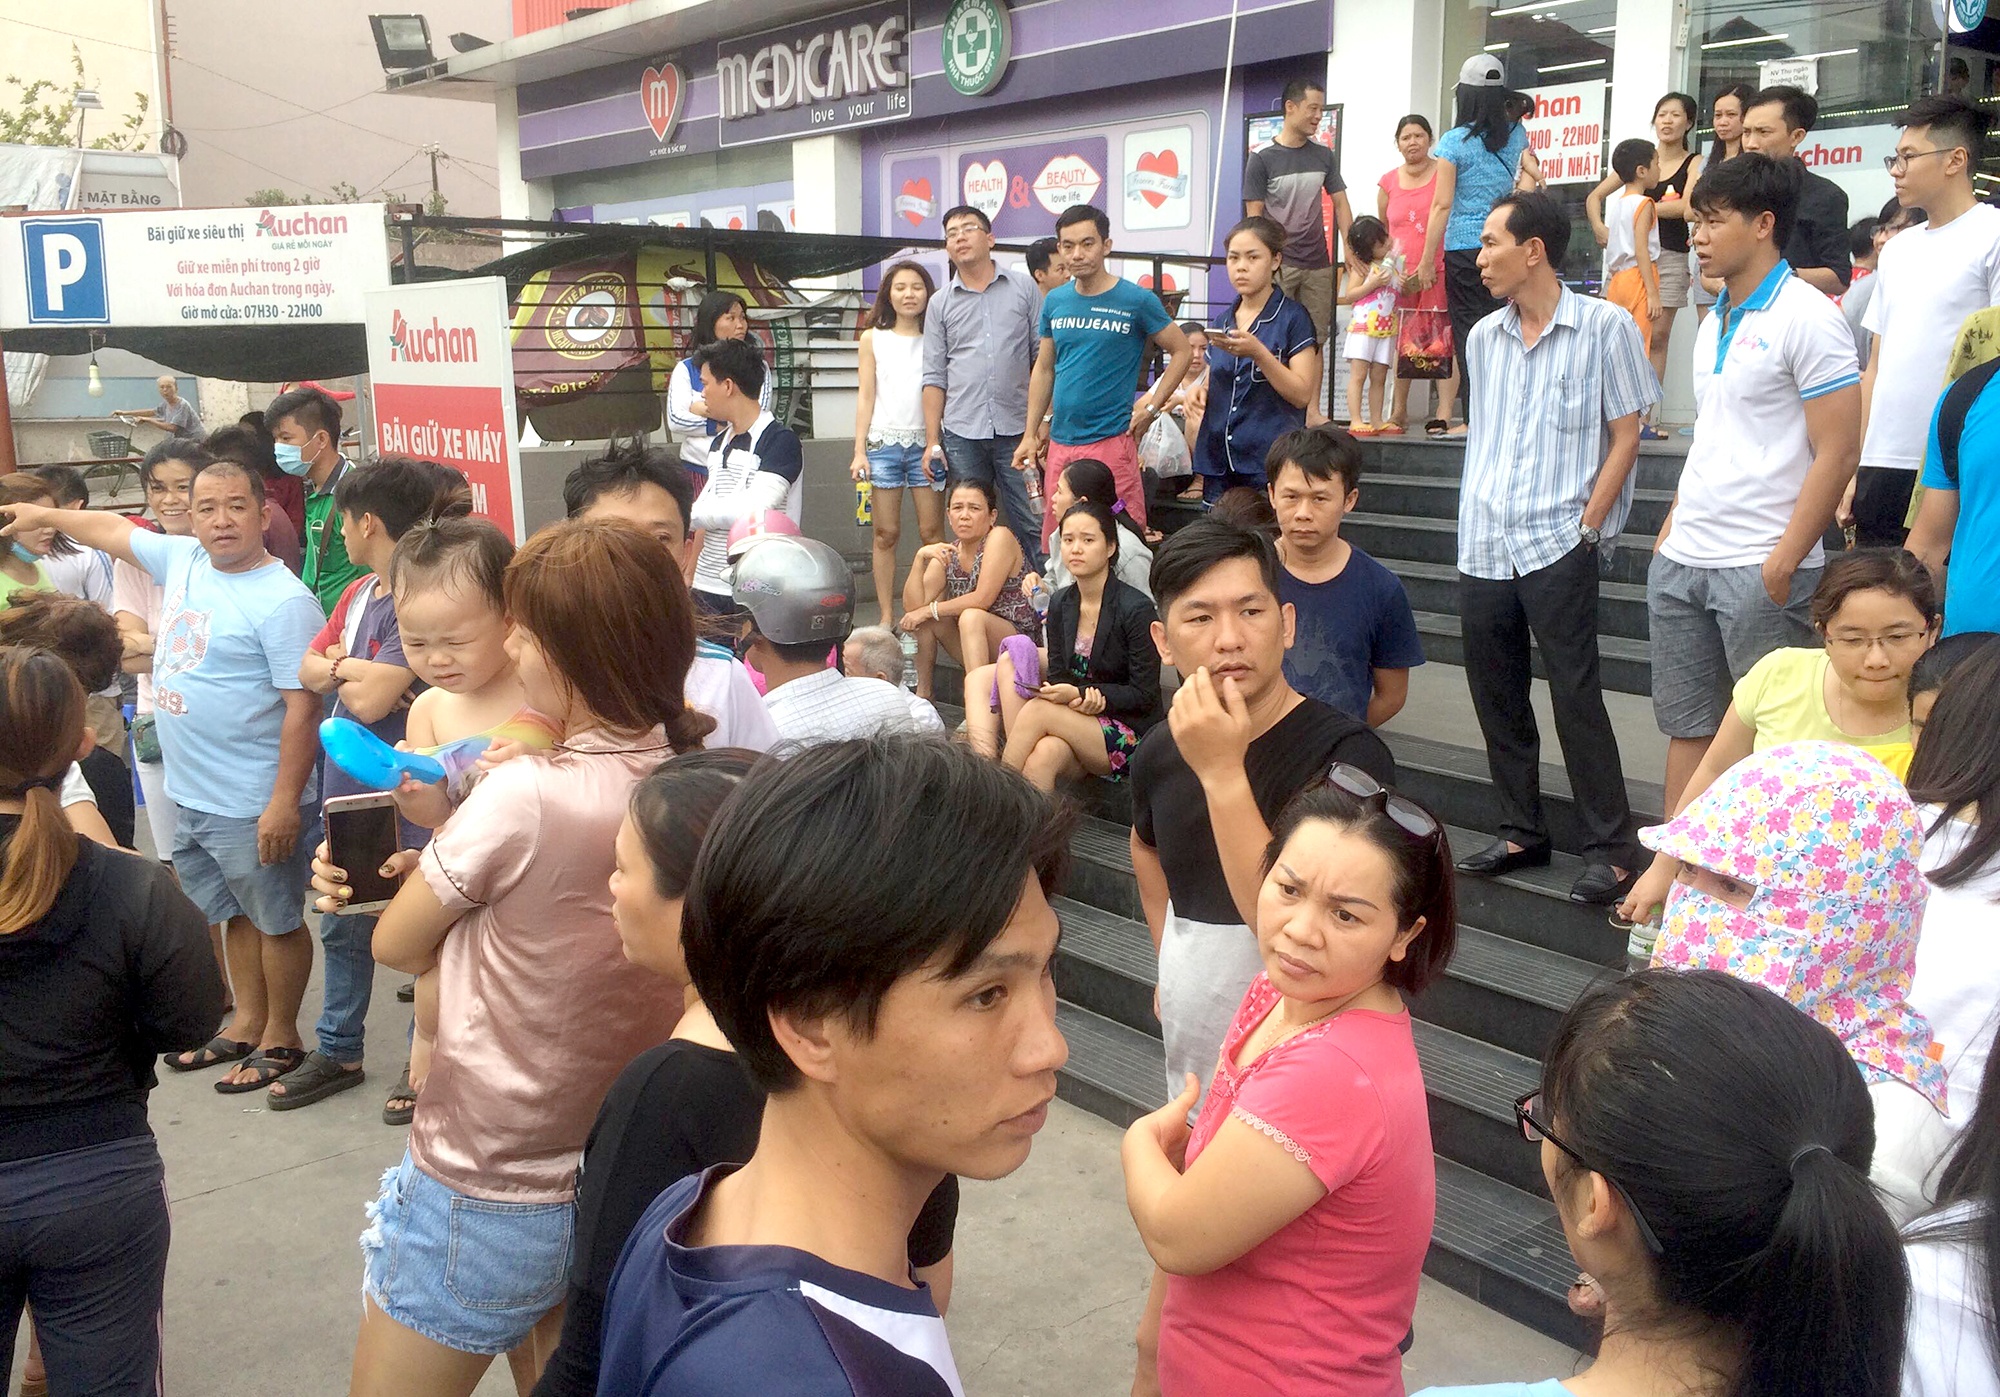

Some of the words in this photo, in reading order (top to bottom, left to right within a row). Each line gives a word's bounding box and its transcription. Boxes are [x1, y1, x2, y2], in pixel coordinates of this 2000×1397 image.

[947, 0, 997, 40] PHARMACY
[984, 51, 995, 74] GPP
[811, 108, 835, 124] love
[848, 102, 875, 120] your
[887, 94, 906, 111] life
[1562, 123, 1600, 147] 22H00
[1541, 152, 1564, 180] CHỦ
[1567, 151, 1600, 180] NHẬT
[968, 178, 1003, 193] HEALTH
[1009, 175, 1031, 209] &
[1046, 169, 1087, 185] BEAUTY
[1051, 193, 1067, 203] love
[1068, 191, 1081, 202] life
[987, 199, 998, 209] life
[147, 226, 165, 241] Bãi
[167, 225, 186, 245] giữ
[188, 227, 201, 240] xe
[203, 224, 226, 240] siêu
[228, 223, 244, 242] thị
[256, 209, 348, 237] Auchan
[42, 233, 87, 311] P
[177, 260, 195, 274] Giữ
[197, 263, 209, 274] xe
[211, 258, 239, 274] miễn
[241, 258, 259, 276] phí
[260, 259, 292, 276] trong
[293, 258, 300, 272] 2
[303, 256, 321, 275] giờ
[166, 283, 183, 297] Với
[185, 282, 205, 297] hóa
[207, 282, 228, 297] đơn
[230, 281, 269, 296] Auchan
[272, 282, 303, 298] trong
[305, 279, 335, 298] ngày.
[181, 305, 199, 319] Giờ
[201, 304, 218, 319] mở
[244, 304, 279, 319] 07H30
[287, 303, 323, 318] 22H00
[390, 309, 478, 363] Auchan
[382, 417, 409, 454] BÃI
[410, 419, 439, 458] GIỮ
[441, 426, 464, 460] XE
[466, 423, 502, 464] MÁY
